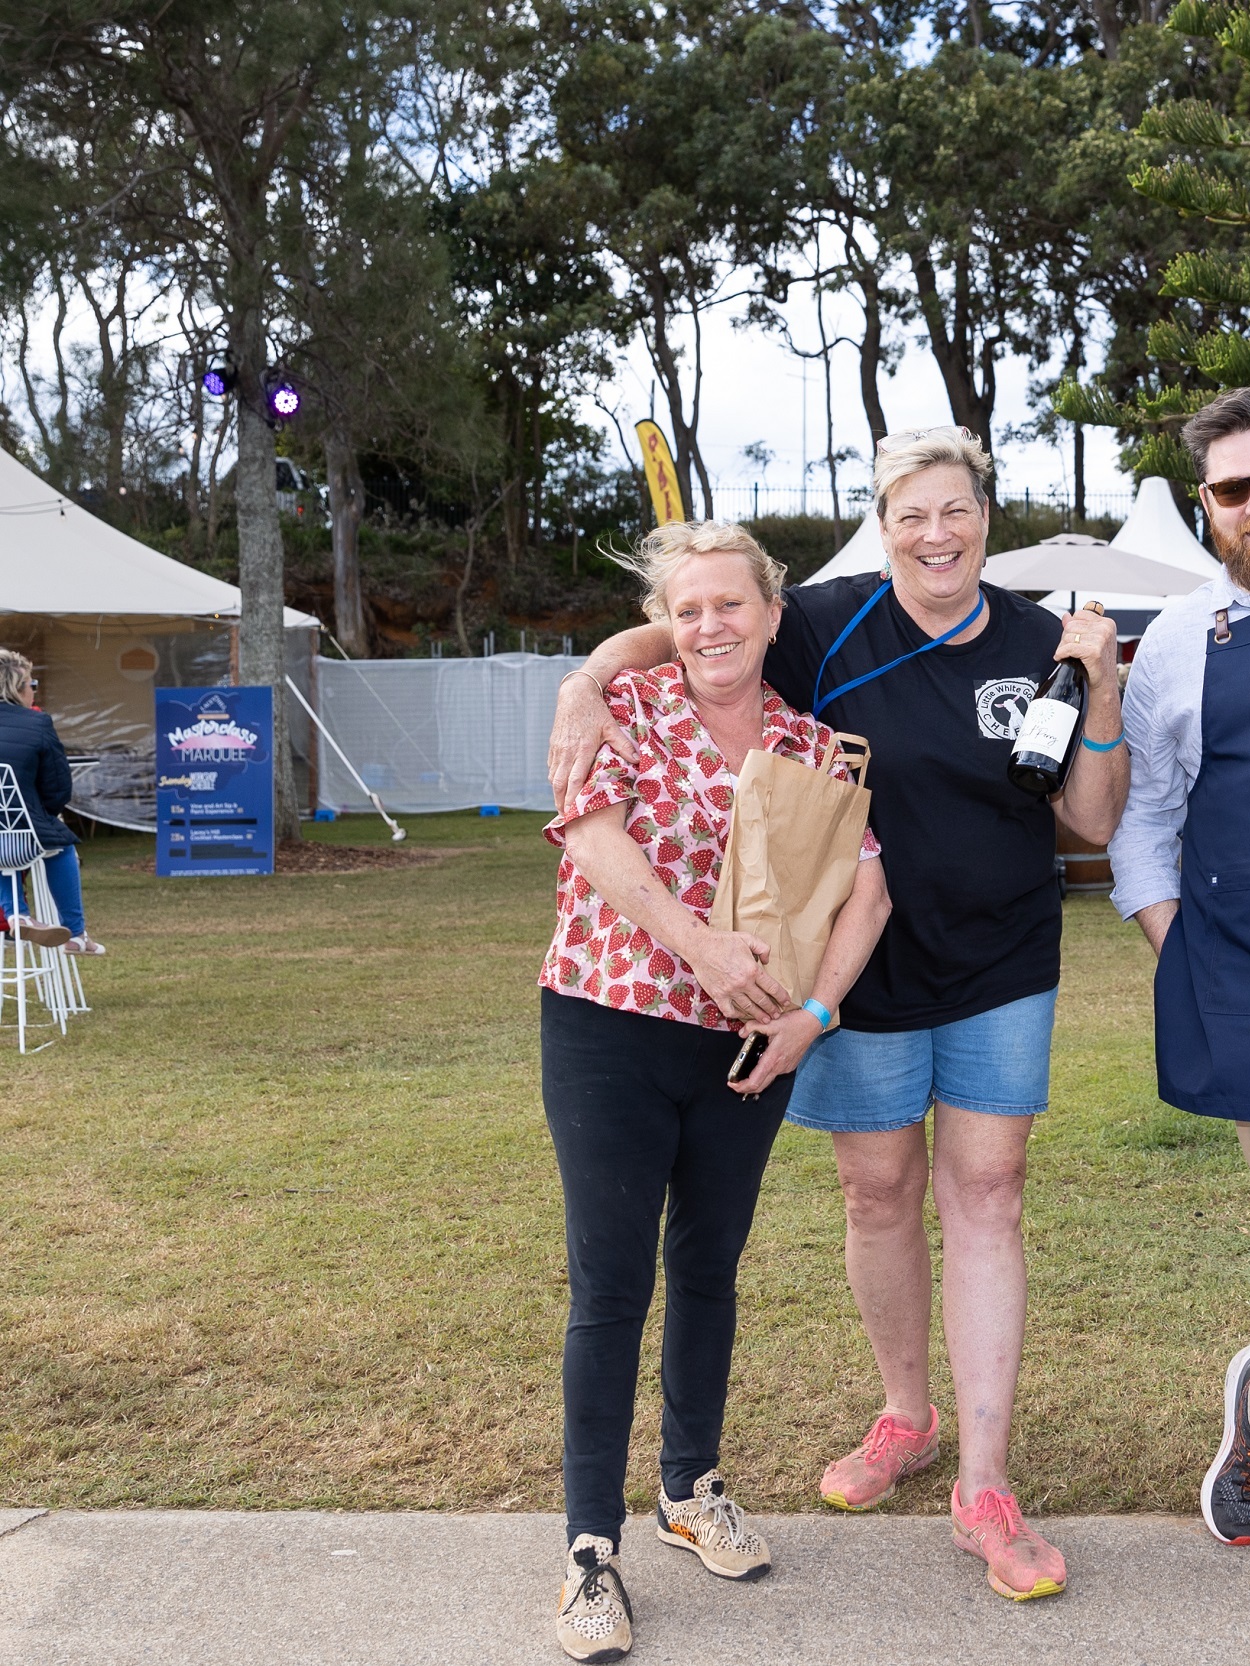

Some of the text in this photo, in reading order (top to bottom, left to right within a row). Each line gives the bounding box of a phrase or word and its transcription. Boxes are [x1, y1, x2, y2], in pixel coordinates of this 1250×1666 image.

[981, 684, 1034, 709] Little White Go
[168, 719, 258, 747] Masterclass
[181, 748, 247, 763] MARQUEE
